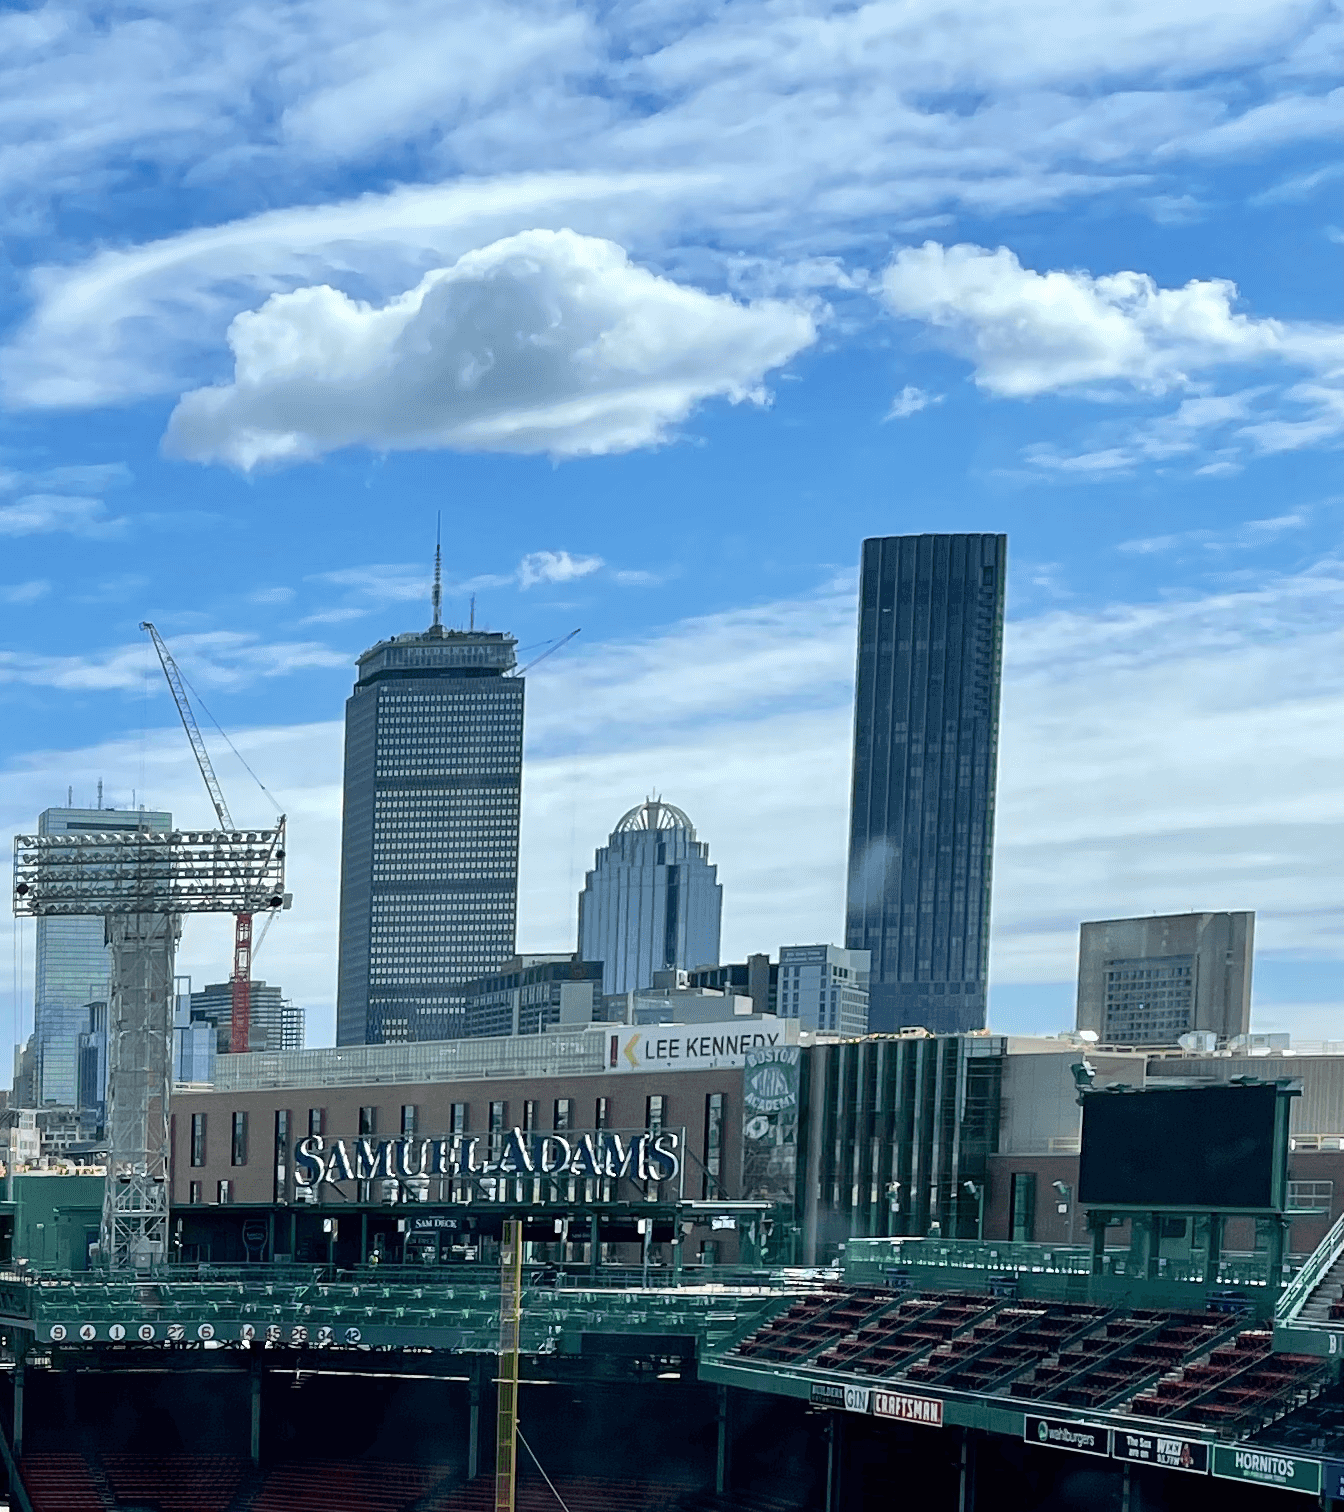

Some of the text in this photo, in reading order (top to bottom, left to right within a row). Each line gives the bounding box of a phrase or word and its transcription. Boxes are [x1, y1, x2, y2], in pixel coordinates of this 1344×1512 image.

[645, 1033, 780, 1060] LEE KENNEDY
[747, 1050, 799, 1068] BOSTON
[294, 1126, 679, 1187] SAMUEL ADAMS
[414, 1218, 458, 1229] SAM DECK
[53, 1327, 63, 1339] 9
[82, 1327, 92, 1339] 4
[142, 1327, 151, 1339] 8
[201, 1326, 211, 1338] 6
[290, 1328, 308, 1340] 26
[846, 1389, 867, 1410] GIN
[875, 1393, 938, 1422] CRAFTSMAN
[1048, 1427, 1095, 1448] wahlburgers
[1126, 1435, 1139, 1447] The
[1235, 1451, 1295, 1478] HORNITOS
